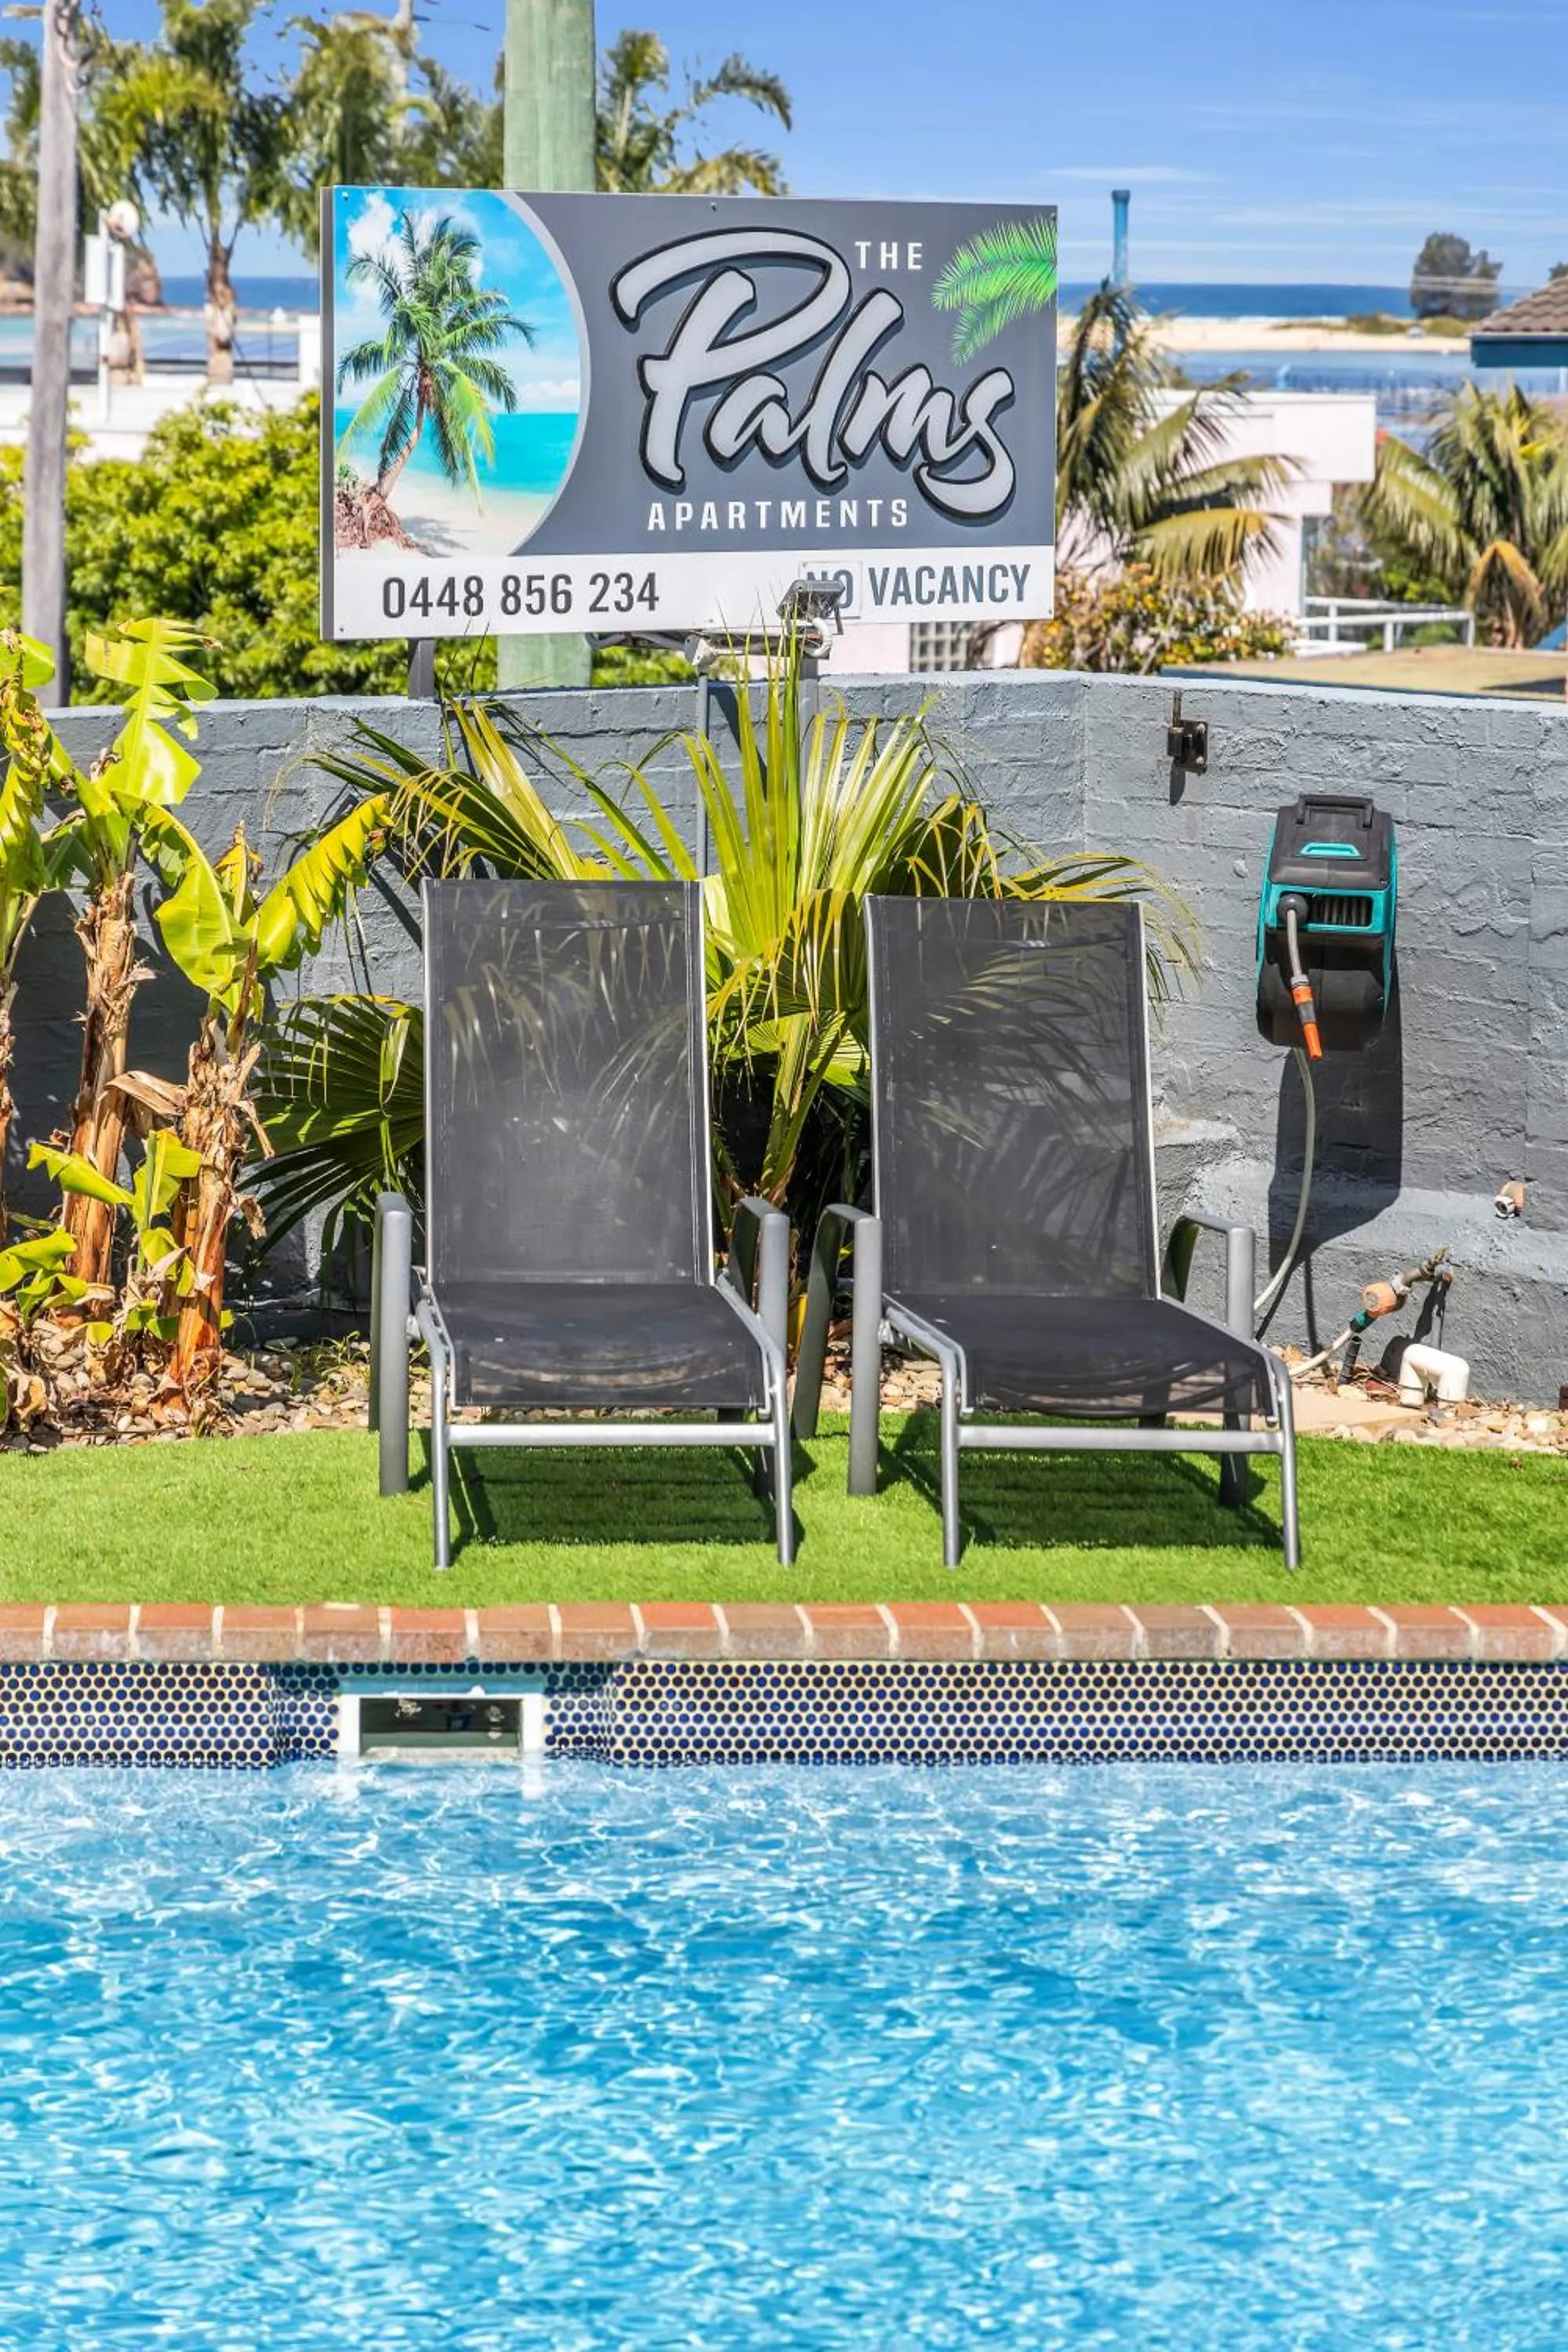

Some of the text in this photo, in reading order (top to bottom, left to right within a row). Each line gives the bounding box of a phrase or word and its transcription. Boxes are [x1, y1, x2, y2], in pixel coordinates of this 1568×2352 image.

[855, 241, 923, 270] THE
[610, 227, 1014, 517] Palms
[648, 498, 909, 532] APARTMENTS
[383, 572, 660, 619] 0448 856 234
[807, 564, 1031, 609] O VACANCY
